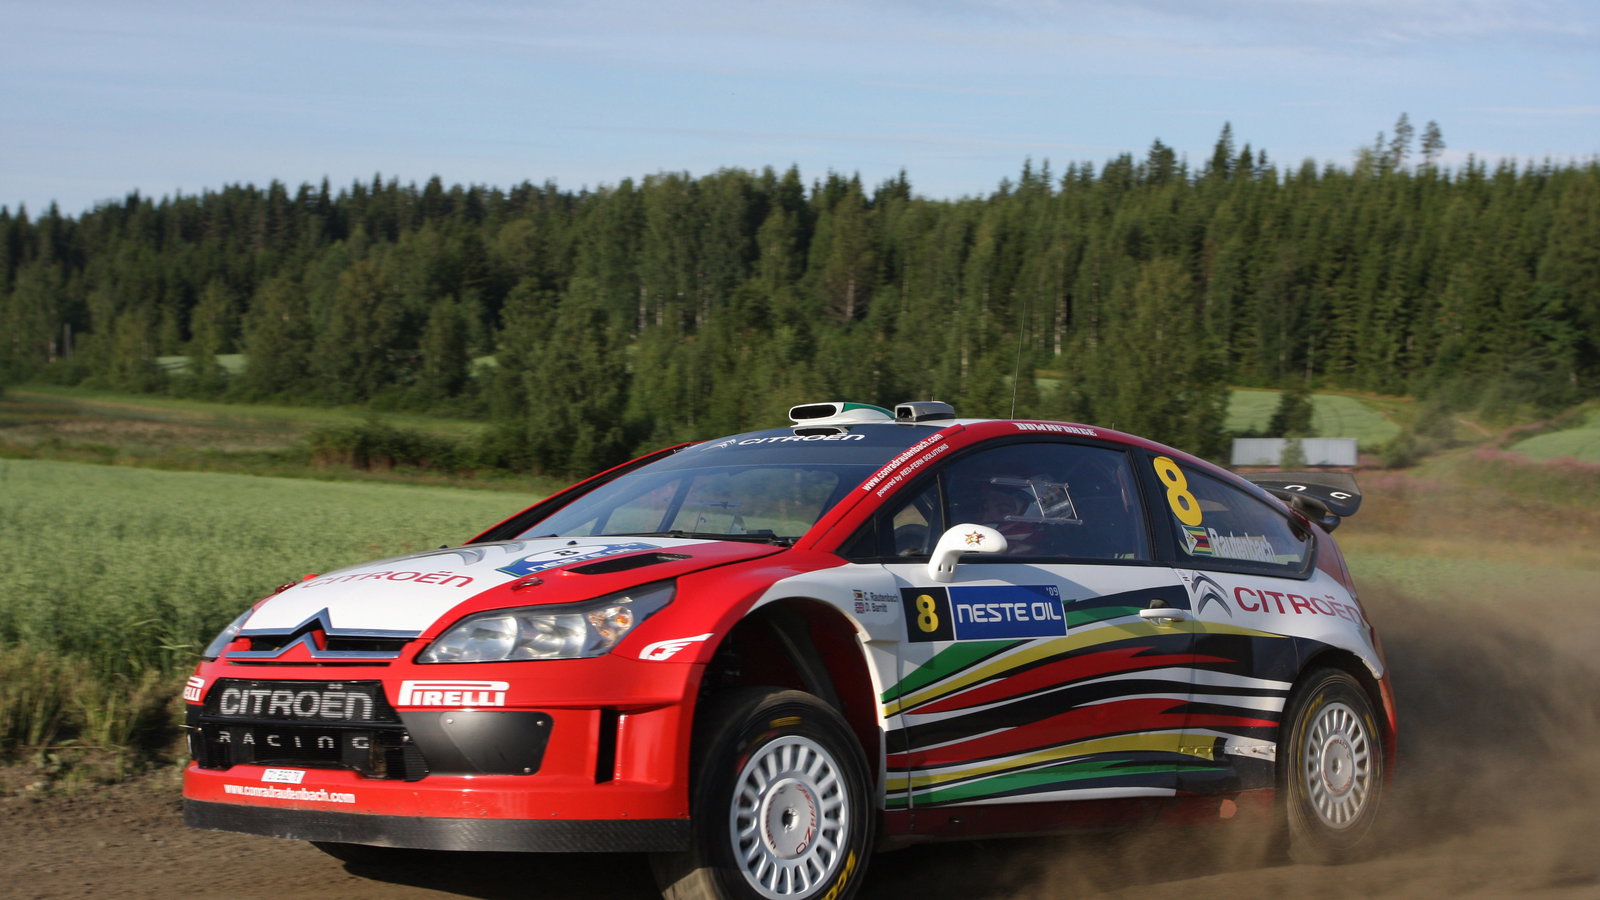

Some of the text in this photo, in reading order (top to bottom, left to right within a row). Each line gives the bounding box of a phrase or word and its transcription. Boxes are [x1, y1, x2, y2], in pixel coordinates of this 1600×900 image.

[1011, 422, 1097, 437] DOWNFORCE
[862, 433, 944, 491] www.conradrautenbach.com
[876, 478, 898, 498] powered
[899, 457, 925, 477] RED-FERN
[922, 443, 949, 462] SOLUTIONS
[1153, 456, 1203, 527] 8
[916, 594, 939, 633] 8
[957, 601, 1062, 624] NESTE OIL
[397, 680, 510, 706] PIRELLI
[219, 731, 370, 750] RACING
[223, 785, 355, 804] www.conradrautenbach.com
